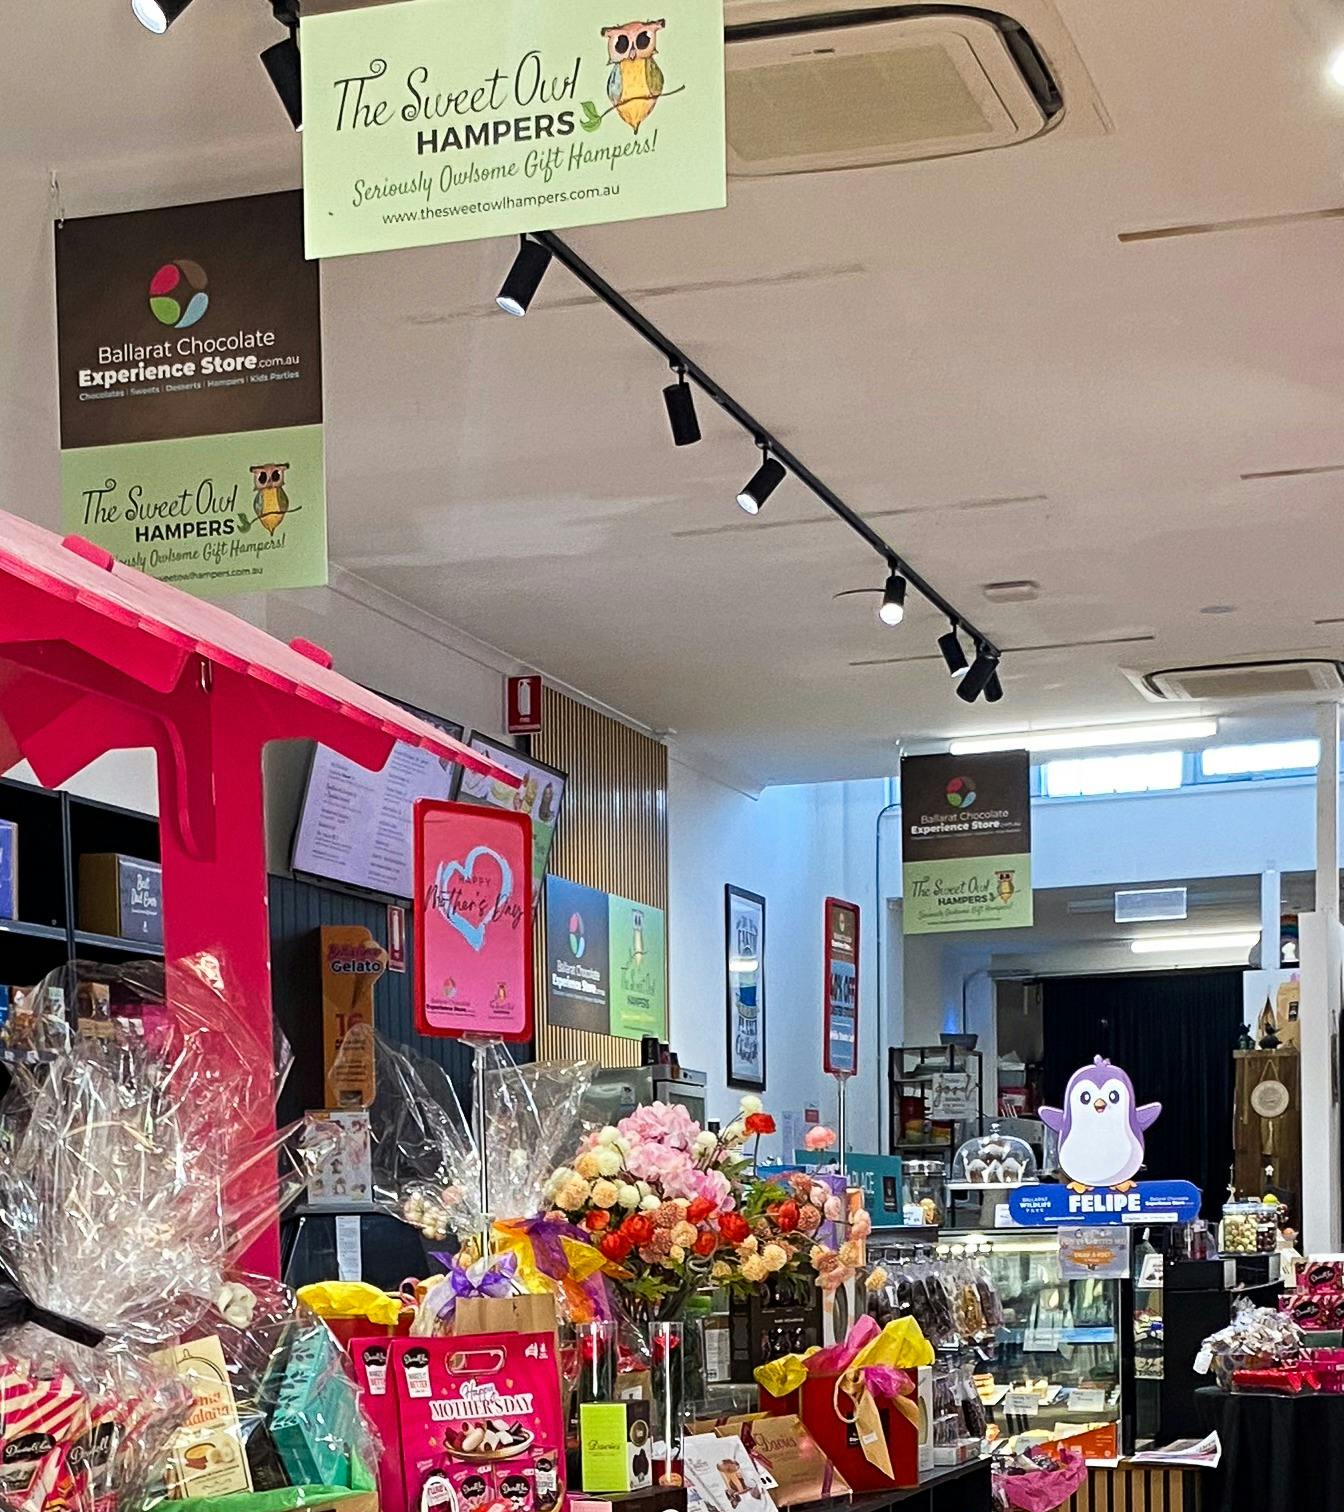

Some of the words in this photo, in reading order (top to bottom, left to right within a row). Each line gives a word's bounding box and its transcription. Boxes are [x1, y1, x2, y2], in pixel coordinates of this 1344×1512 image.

[333, 58, 394, 132] The
[400, 67, 509, 123] Sweet
[513, 49, 582, 103] Owl
[416, 111, 576, 156] HAMPERS
[352, 174, 434, 208] Seriously
[440, 161, 519, 194] Owlsome
[523, 143, 564, 184] Gift
[567, 128, 659, 176] Hampers!
[381, 184, 621, 226] www.thesweetowlhampers.com.au
[97, 340, 172, 365] Ballarat
[176, 329, 276, 357] Chocolate
[78, 361, 196, 388] Experience
[82, 477, 122, 526] The
[124, 484, 192, 522] Sweet
[195, 477, 238, 514] Owl
[135, 517, 236, 544] HAMPERS
[149, 547, 200, 568] Owlsome
[202, 537, 228, 565] Gift
[229, 532, 287, 560] Hampers!
[910, 822, 970, 836] Experience
[937, 895, 989, 907] HAMPERS
[331, 959, 383, 973] Gelato
[1019, 1201, 1053, 1210] WILDLIFE
[1068, 1193, 1142, 1214] FELIPE
[504, 1395, 534, 1415] DAY
